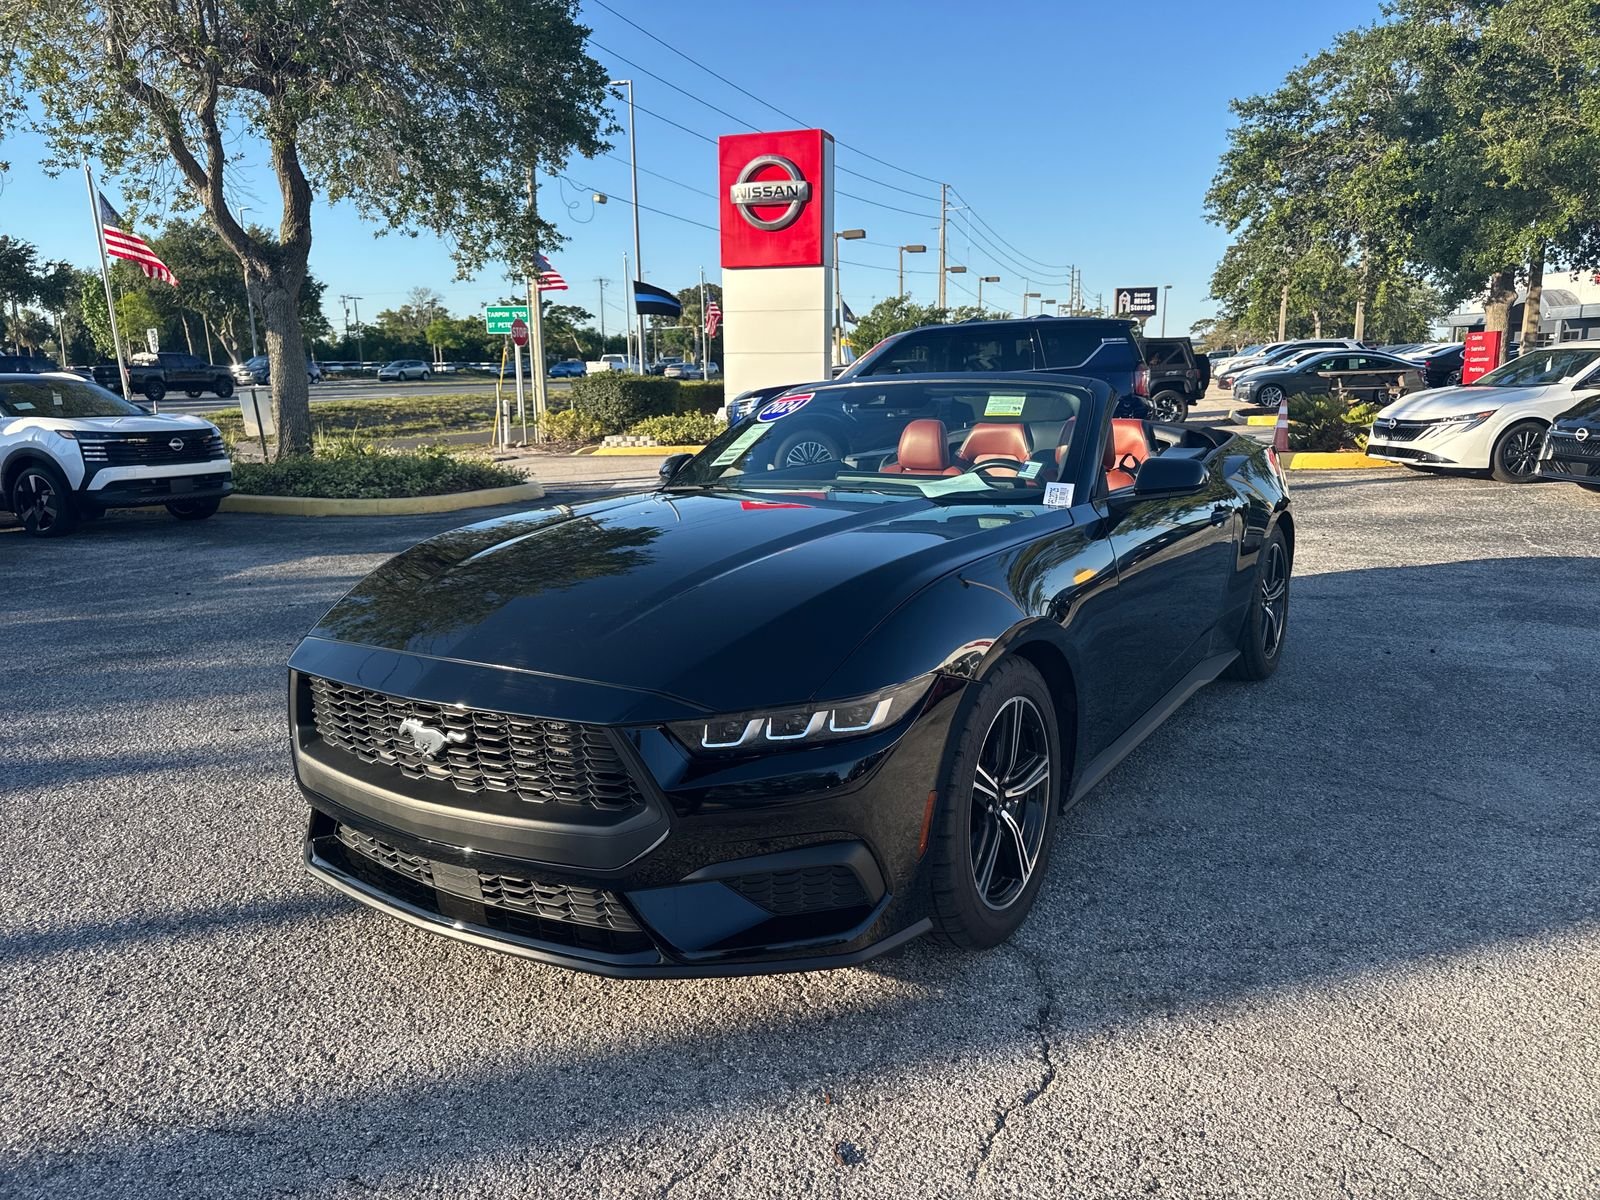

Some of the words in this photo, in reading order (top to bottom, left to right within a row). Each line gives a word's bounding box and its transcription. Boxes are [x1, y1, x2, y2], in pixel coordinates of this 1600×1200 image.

[736, 184, 799, 199] NISSAN
[488, 321, 496, 329] ST
[512, 327, 527, 338] STOP
